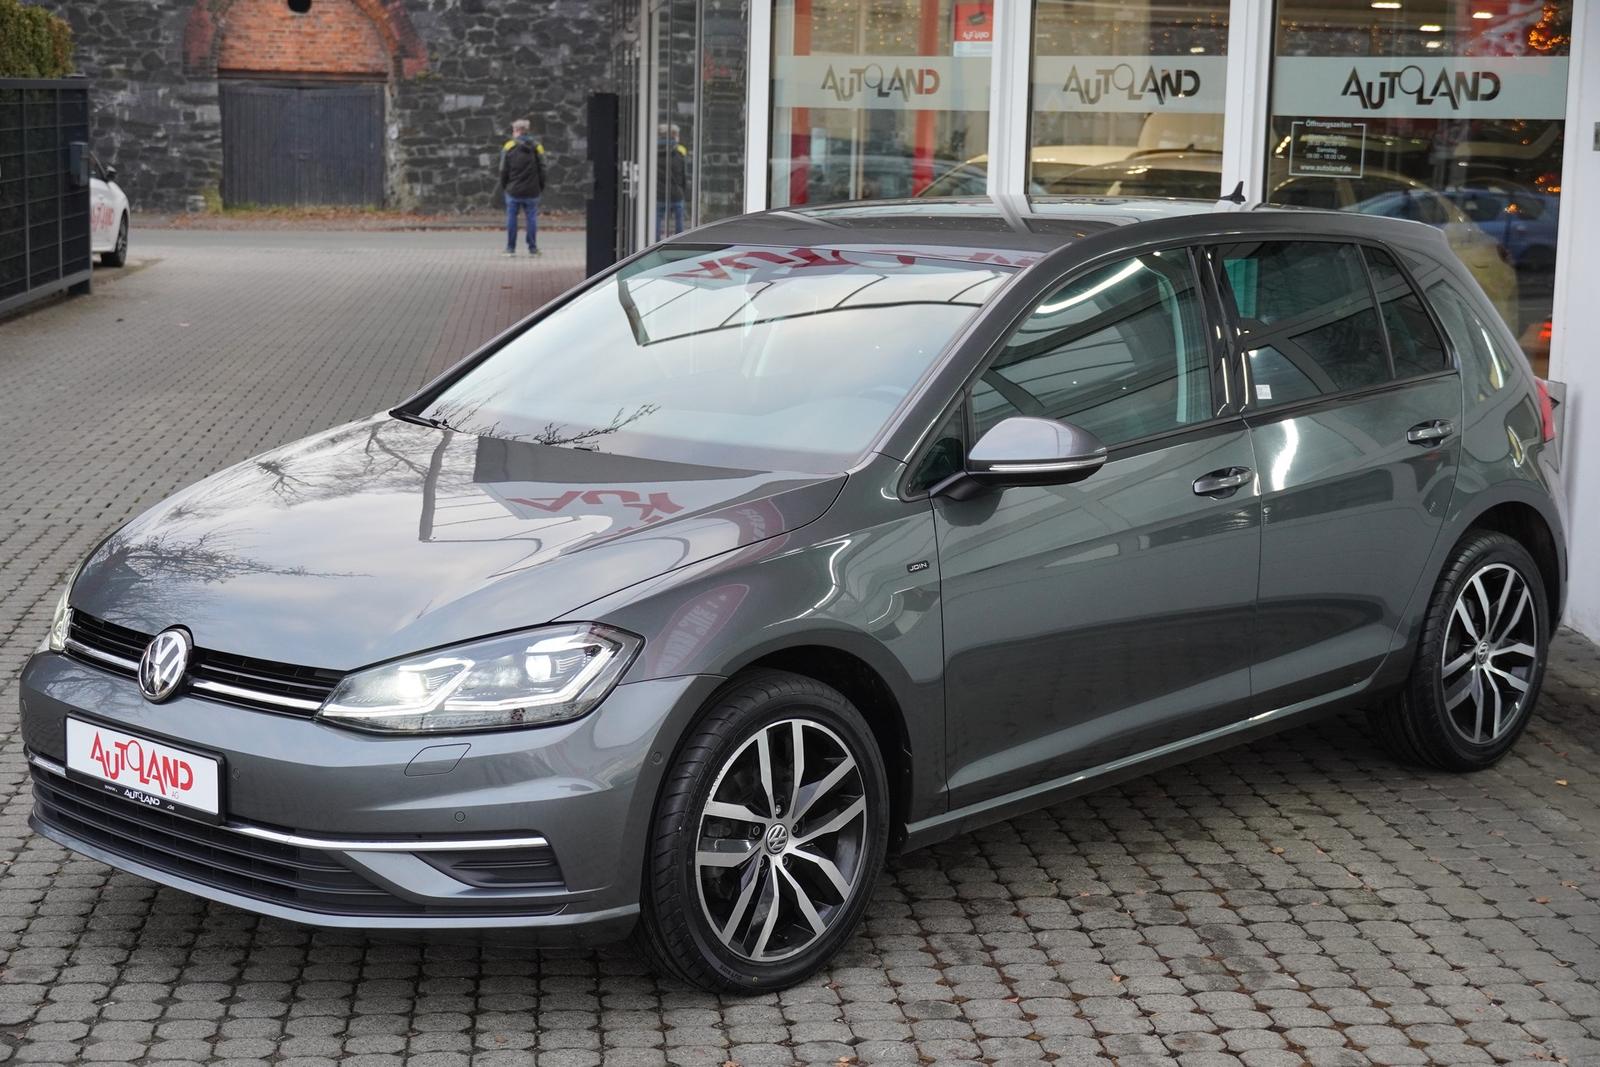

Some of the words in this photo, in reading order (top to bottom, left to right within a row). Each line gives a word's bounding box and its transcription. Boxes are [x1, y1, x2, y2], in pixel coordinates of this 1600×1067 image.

[821, 63, 940, 102] AUTOLAND
[1063, 63, 1201, 105] AUTOLAND
[1341, 65, 1501, 110] AUTOLAND
[1305, 119, 1352, 129] Öffnungszeiten
[1300, 164, 1353, 173] www.autoland.de
[909, 562, 928, 572] JOIN
[90, 731, 194, 795] AUTOLAND
[124, 789, 160, 805] AUTOLAND
